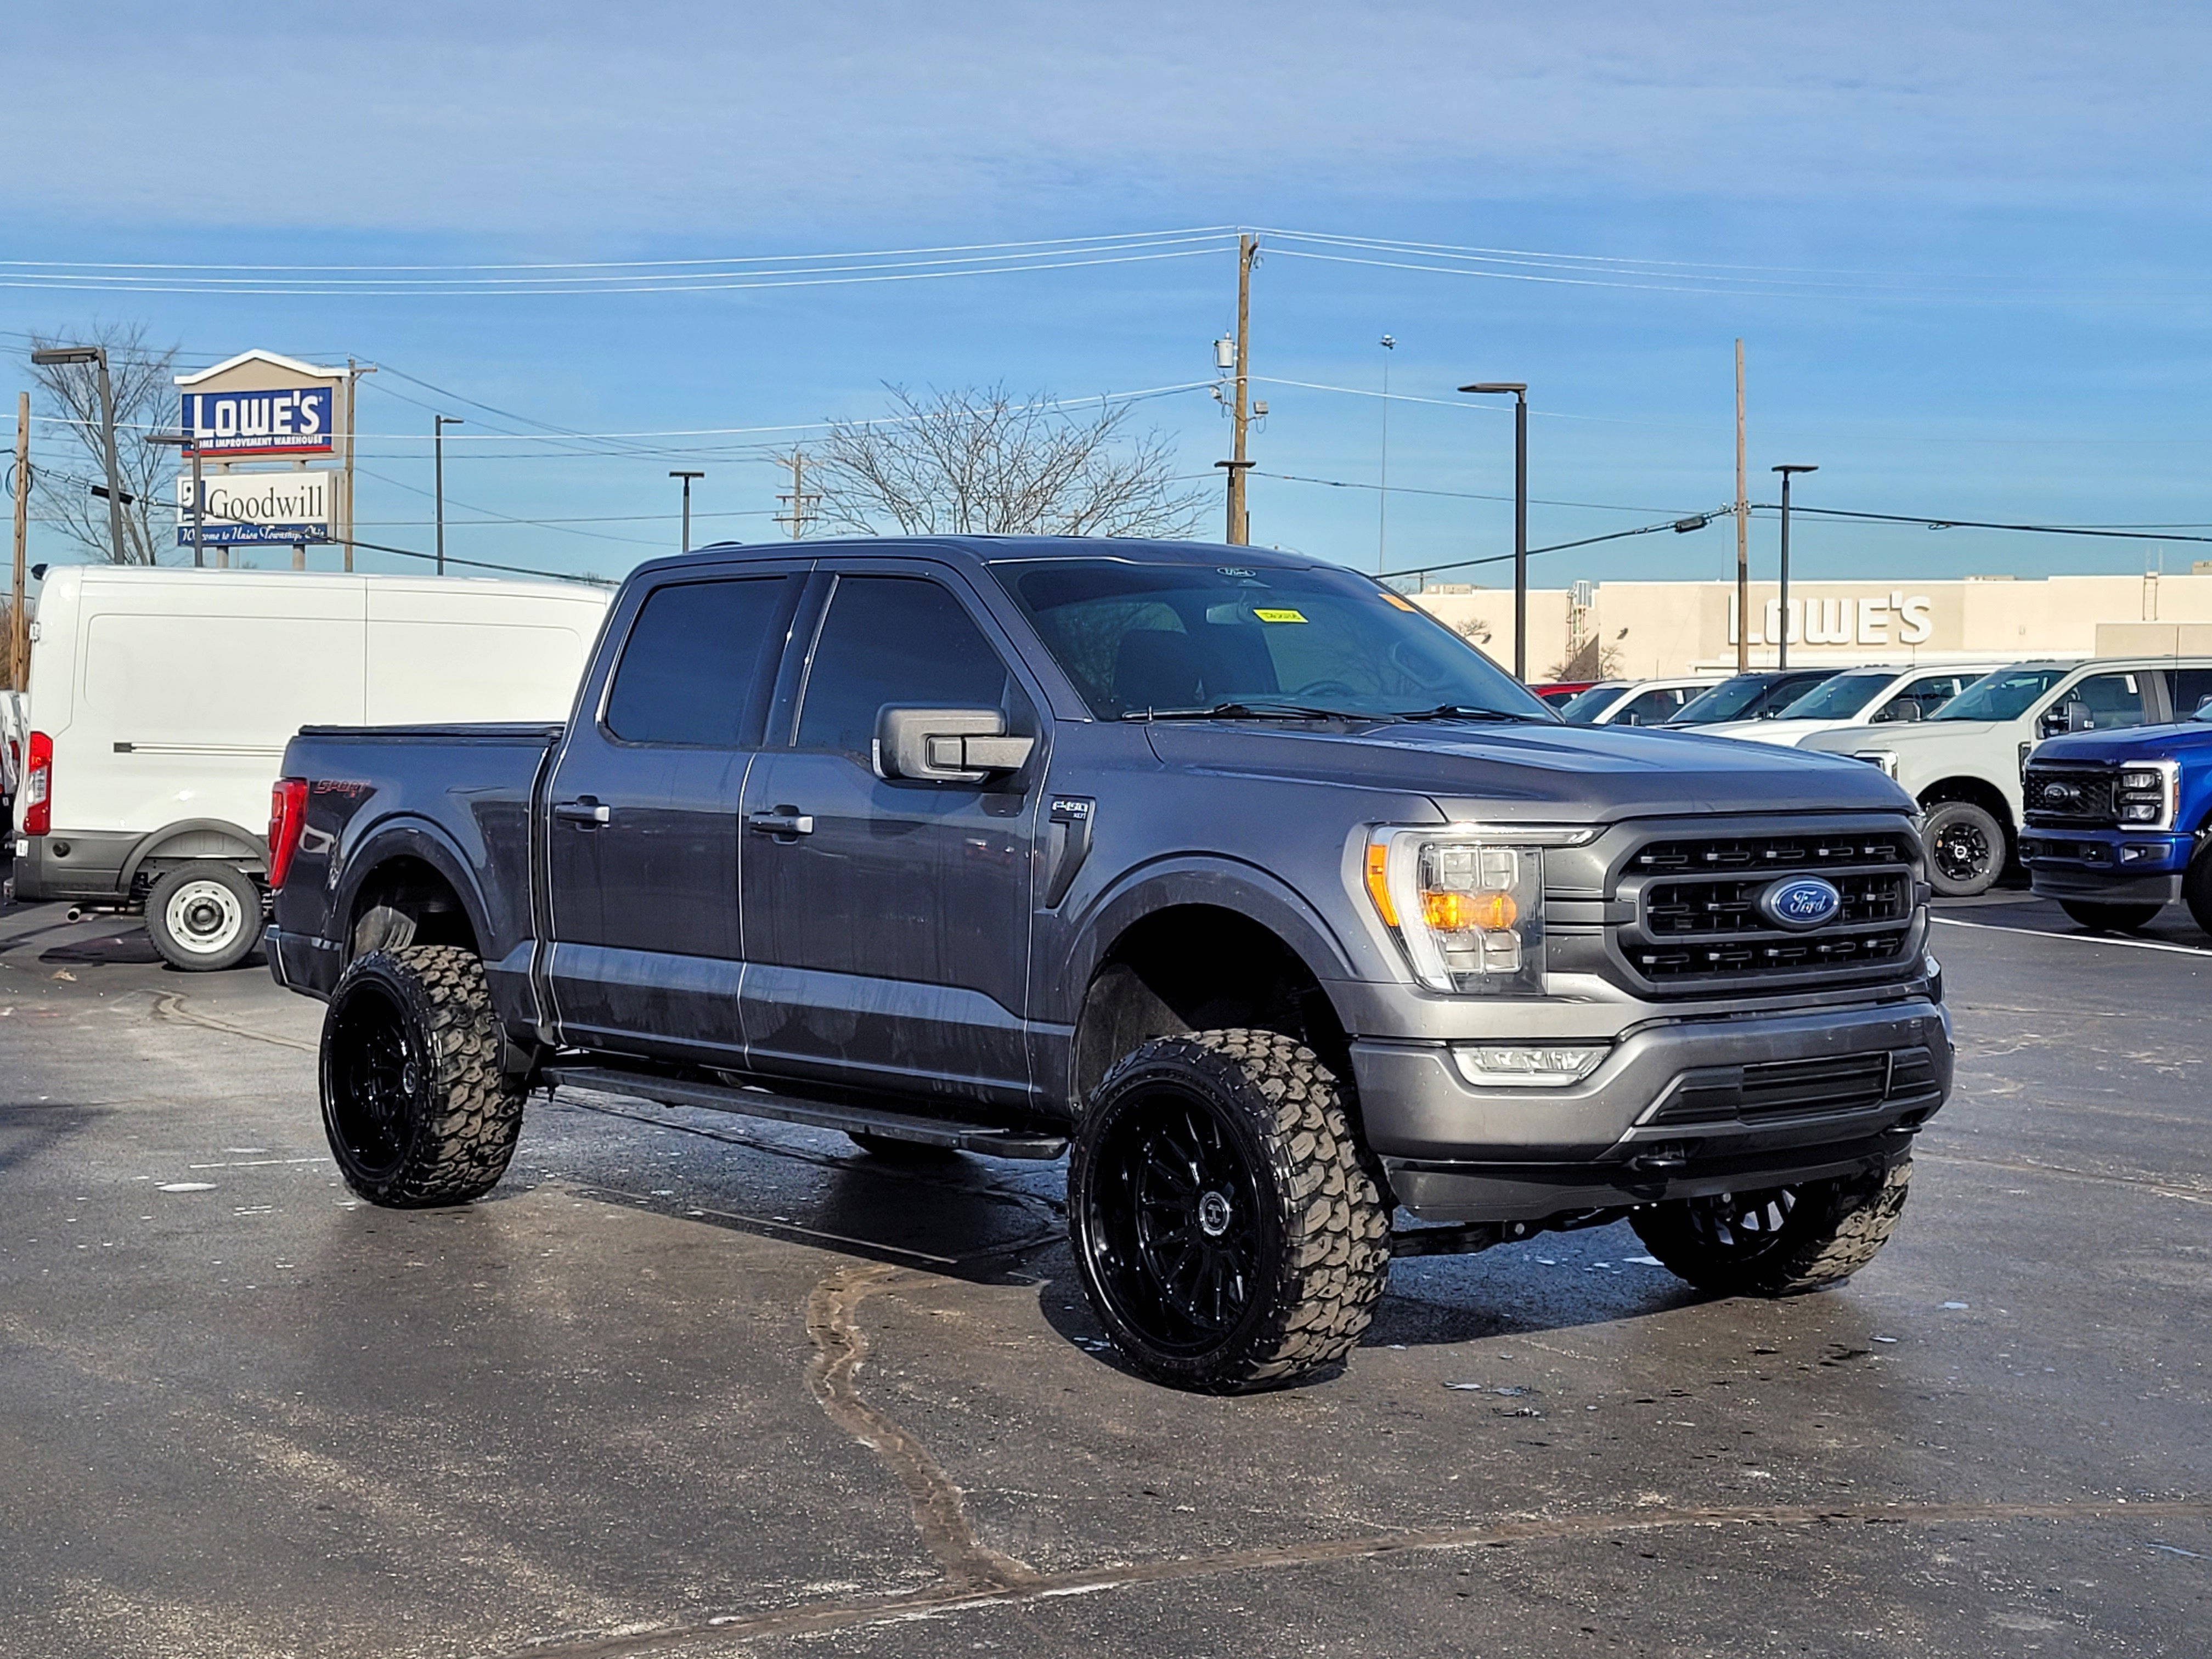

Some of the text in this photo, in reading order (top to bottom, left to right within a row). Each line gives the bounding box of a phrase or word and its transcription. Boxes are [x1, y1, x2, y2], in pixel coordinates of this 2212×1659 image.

[194, 390, 321, 438] LOWE'S
[216, 437, 273, 448] IMPROVEMENT
[274, 435, 323, 445] WAREHOUSE
[209, 485, 324, 520] Goodwill
[222, 531, 230, 540] to
[232, 526, 258, 540] Union
[1728, 590, 1933, 645] LOWE'S
[1790, 890, 1827, 914] Ford
